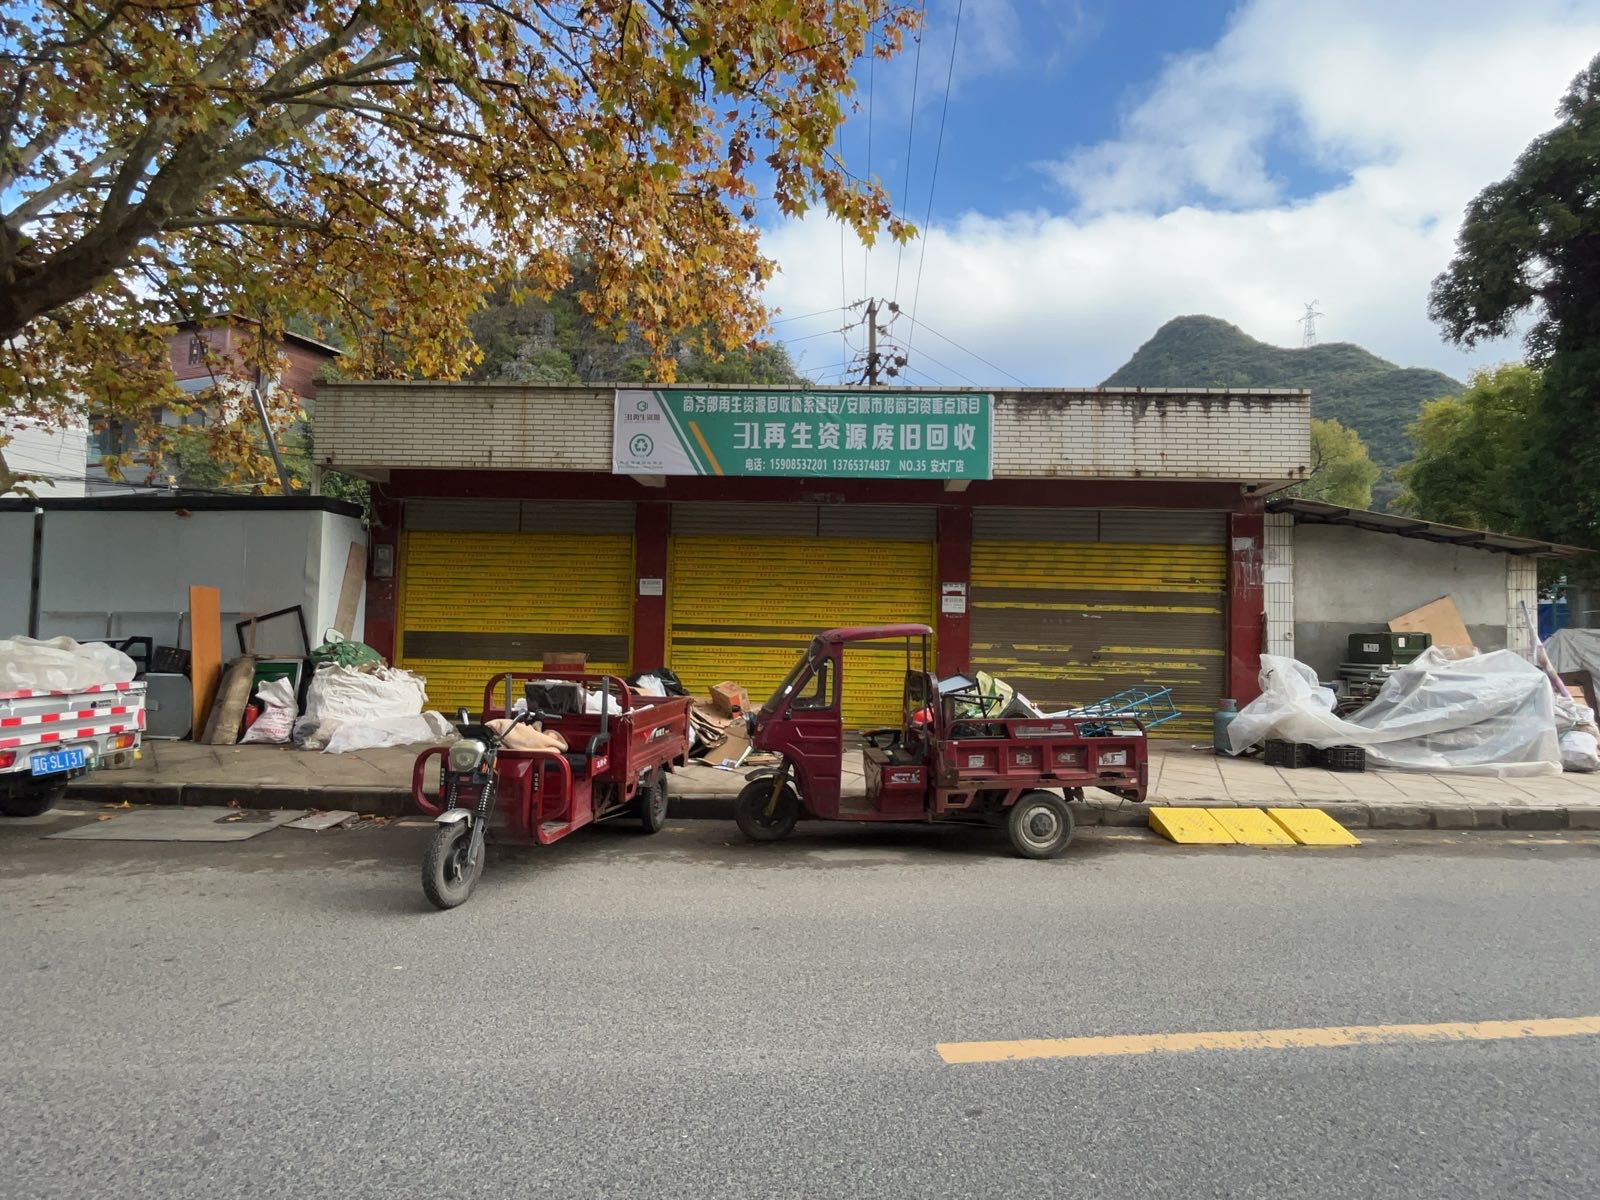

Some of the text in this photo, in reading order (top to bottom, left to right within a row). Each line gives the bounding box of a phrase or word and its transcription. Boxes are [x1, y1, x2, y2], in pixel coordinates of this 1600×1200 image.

[770, 459, 827, 472] 15908537201
[832, 460, 890, 472] 13765374837
[899, 460, 927, 472] NO.35
[930, 459, 964, 473] 安大厂店
